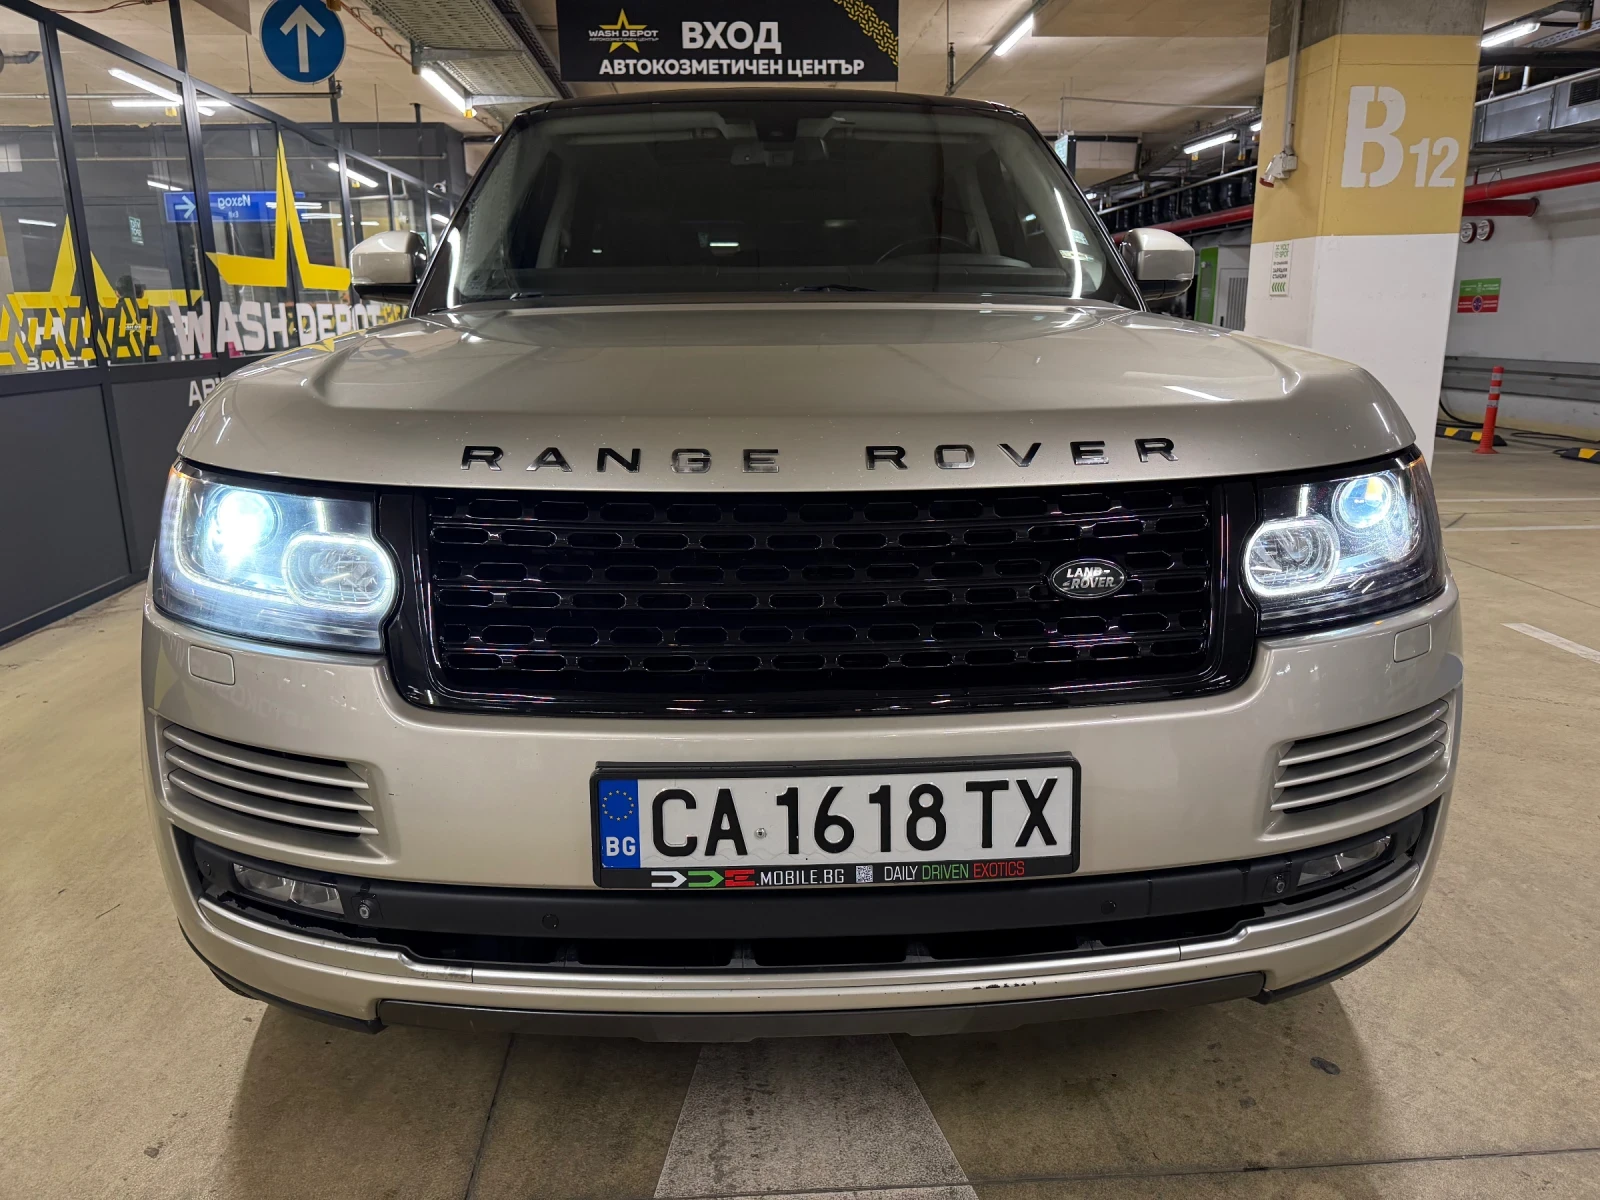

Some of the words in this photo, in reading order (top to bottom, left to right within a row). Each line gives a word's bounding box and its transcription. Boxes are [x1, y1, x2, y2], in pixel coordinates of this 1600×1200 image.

[588, 29, 619, 37] WASH
[622, 29, 659, 37] DEPOT
[681, 21, 782, 54] ВХОД
[599, 59, 783, 76] АВТОКОЗМЕТИЧЕН
[787, 59, 865, 78] ЦЕНТЪР
[169, 300, 289, 356] WASH
[460, 445, 781, 474] RANGE
[865, 437, 1180, 472] ROVER
[1070, 576, 1115, 590] ROVER
[651, 786, 748, 858] CA
[776, 782, 947, 856] 1618
[965, 777, 1058, 850] TX
[605, 836, 637, 858] BG
[884, 865, 918, 881] DAILY
[922, 863, 969, 880] DRIVEN
[973, 861, 1025, 878] EXOTICS
